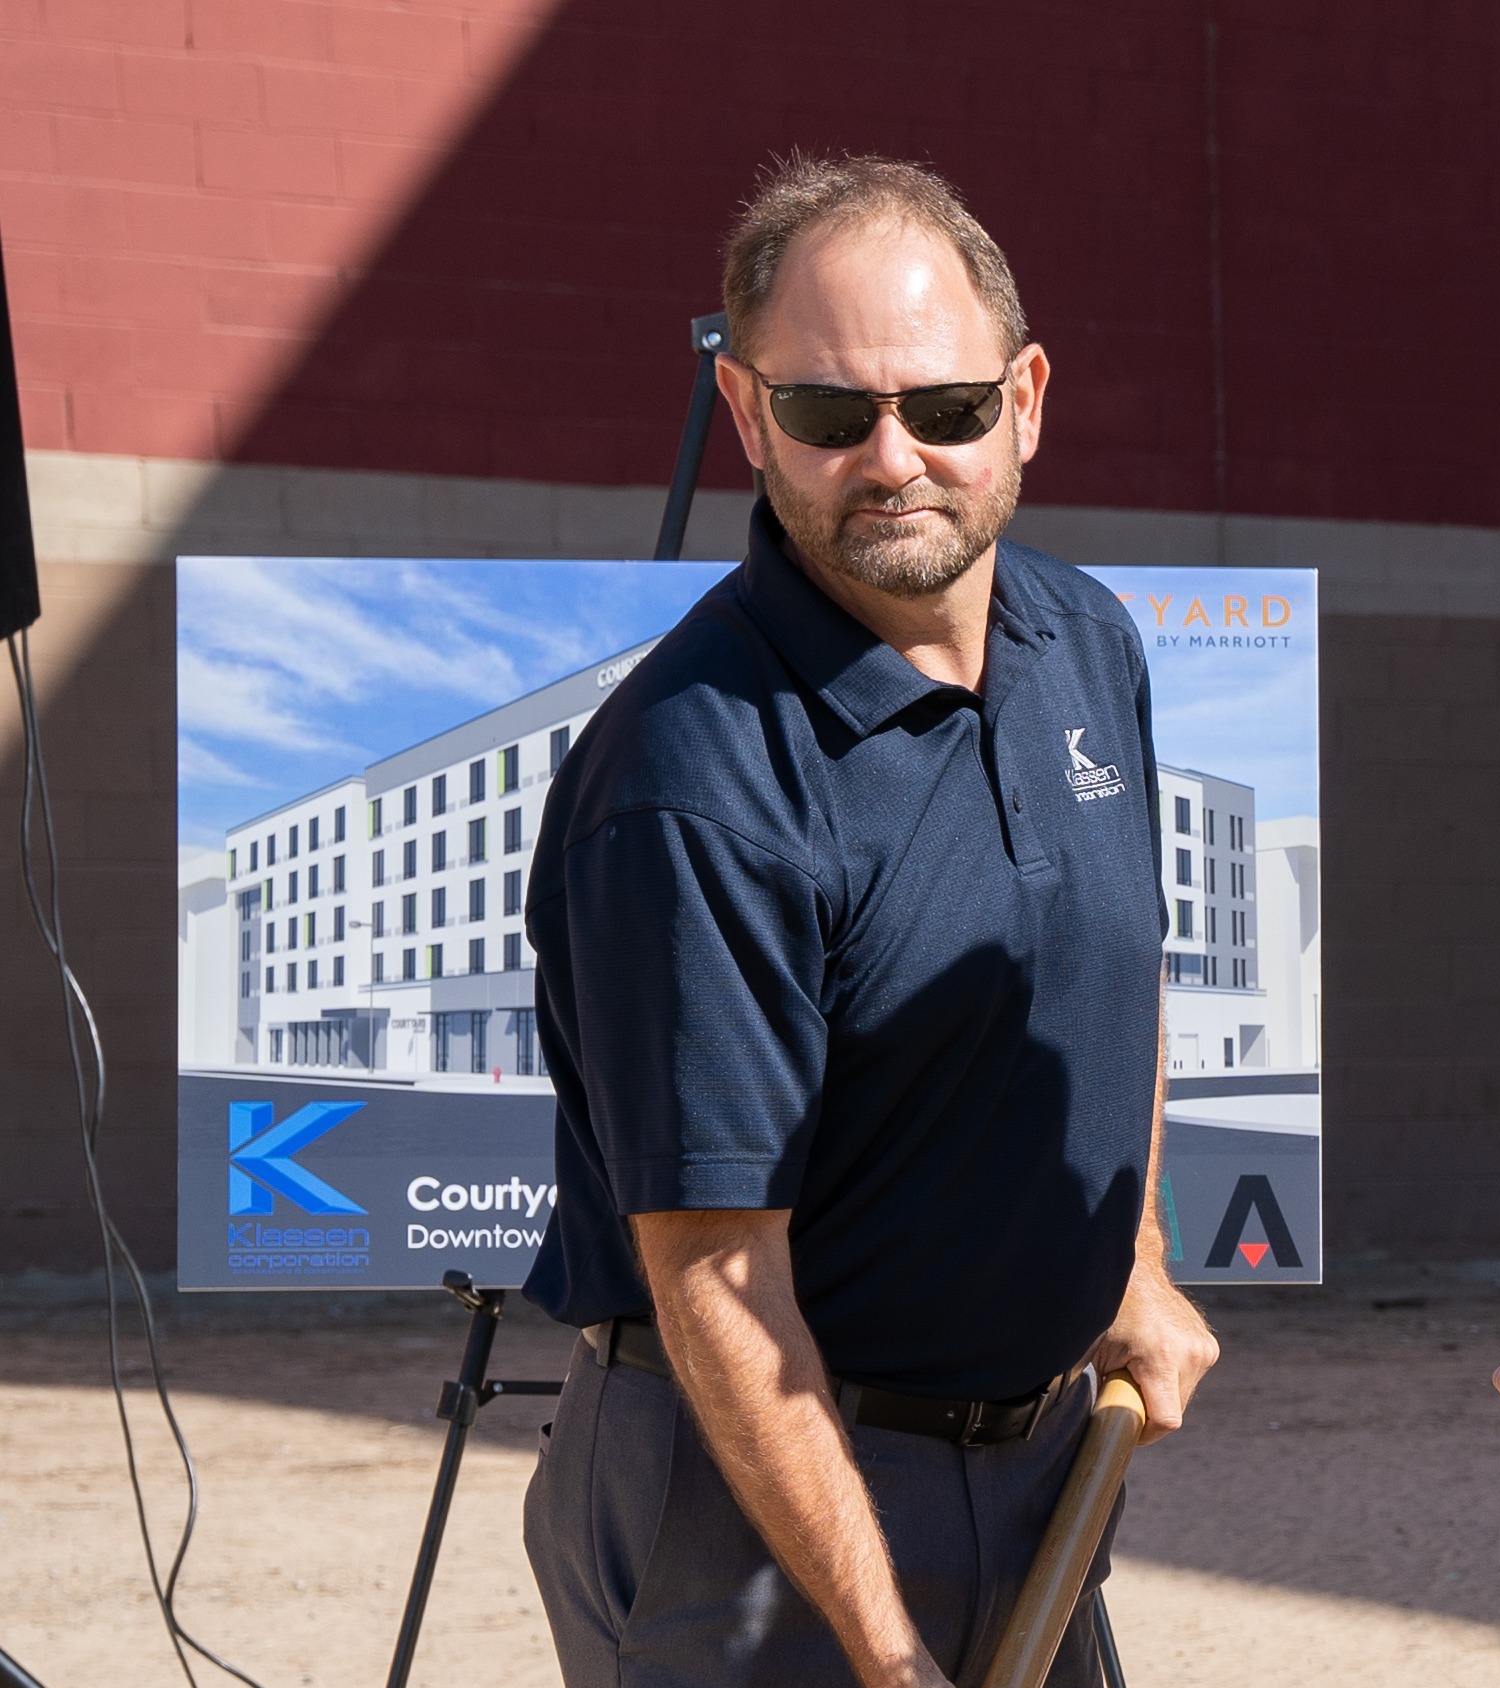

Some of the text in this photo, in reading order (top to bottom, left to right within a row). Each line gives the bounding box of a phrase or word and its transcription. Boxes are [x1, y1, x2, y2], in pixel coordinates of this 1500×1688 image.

[1116, 594, 1292, 628] YARD
[1156, 635, 1292, 649] BY MARRIOTT
[228, 1101, 370, 1217] K
[228, 1222, 370, 1248] Klassen
[407, 1223, 547, 1250] Downtow
[228, 1251, 370, 1270] corporation
